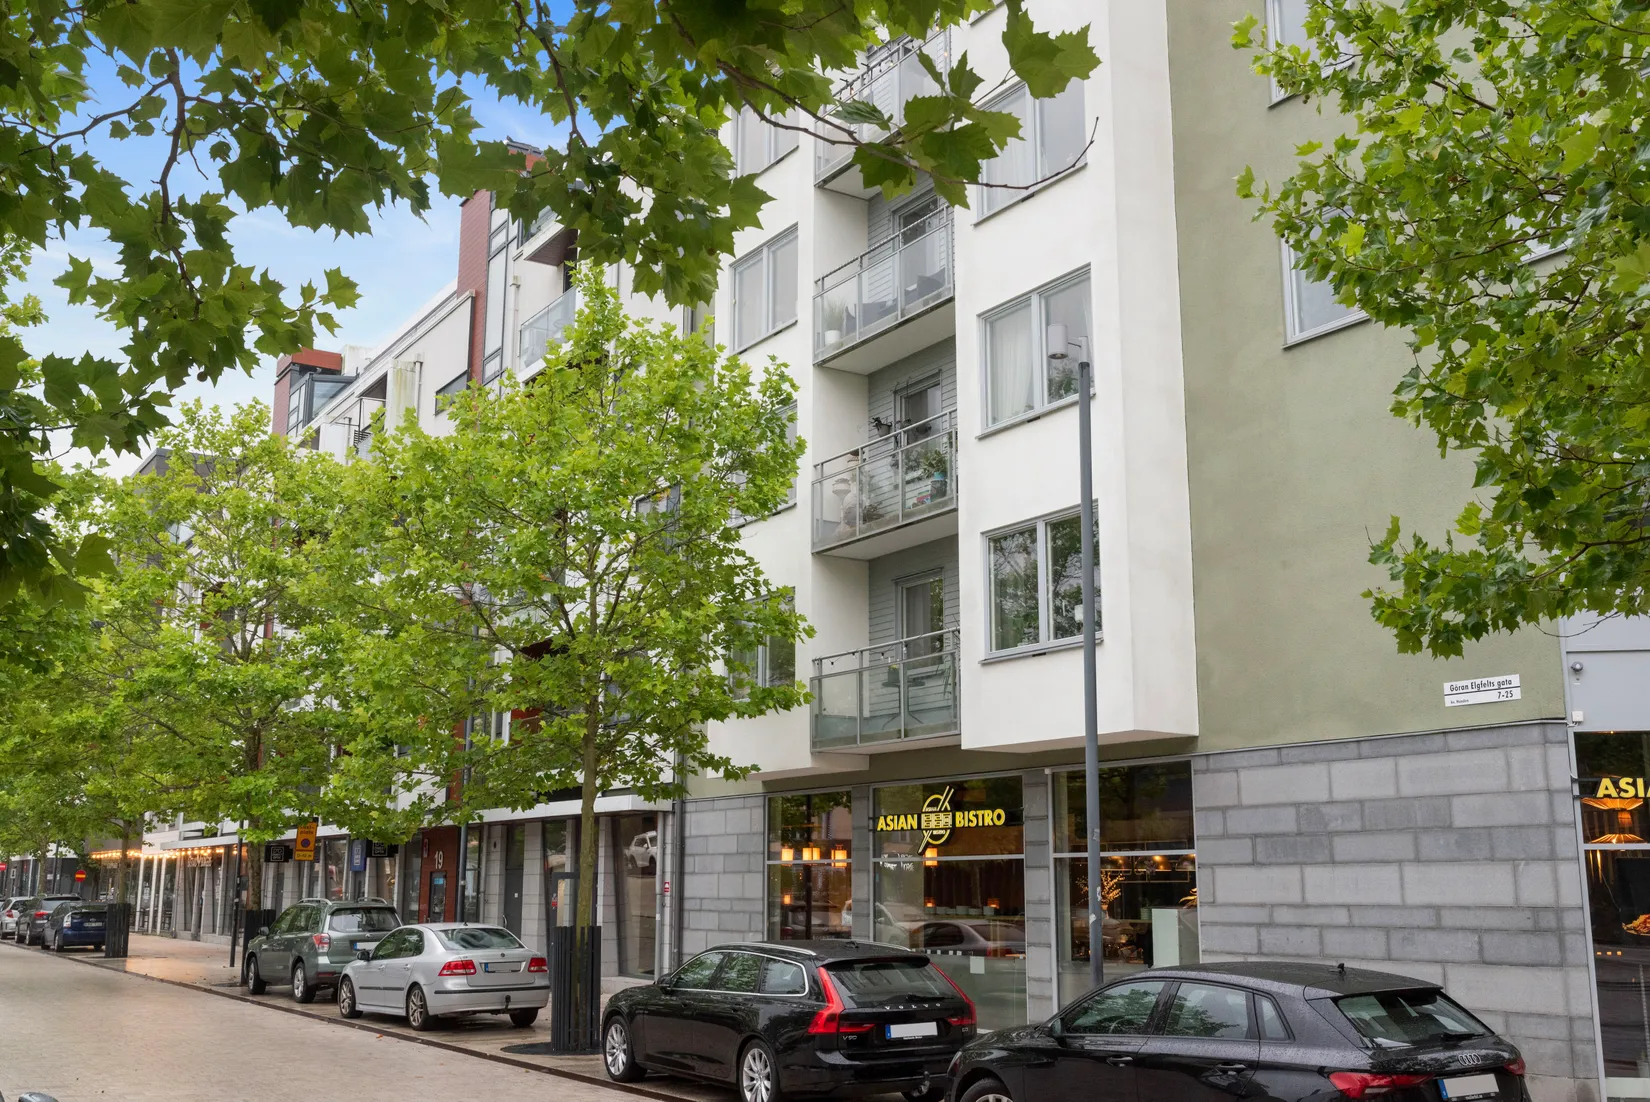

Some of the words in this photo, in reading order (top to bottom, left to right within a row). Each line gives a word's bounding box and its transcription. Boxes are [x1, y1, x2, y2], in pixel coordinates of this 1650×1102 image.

[1470, 680, 1494, 691] Elgfelts
[1496, 679, 1512, 688] gata
[1498, 690, 1514, 699] 7-25
[1596, 778, 1650, 798] ASI
[877, 814, 918, 832] ASIAN
[956, 809, 1006, 828] BISTRO
[434, 850, 443, 869] 19
